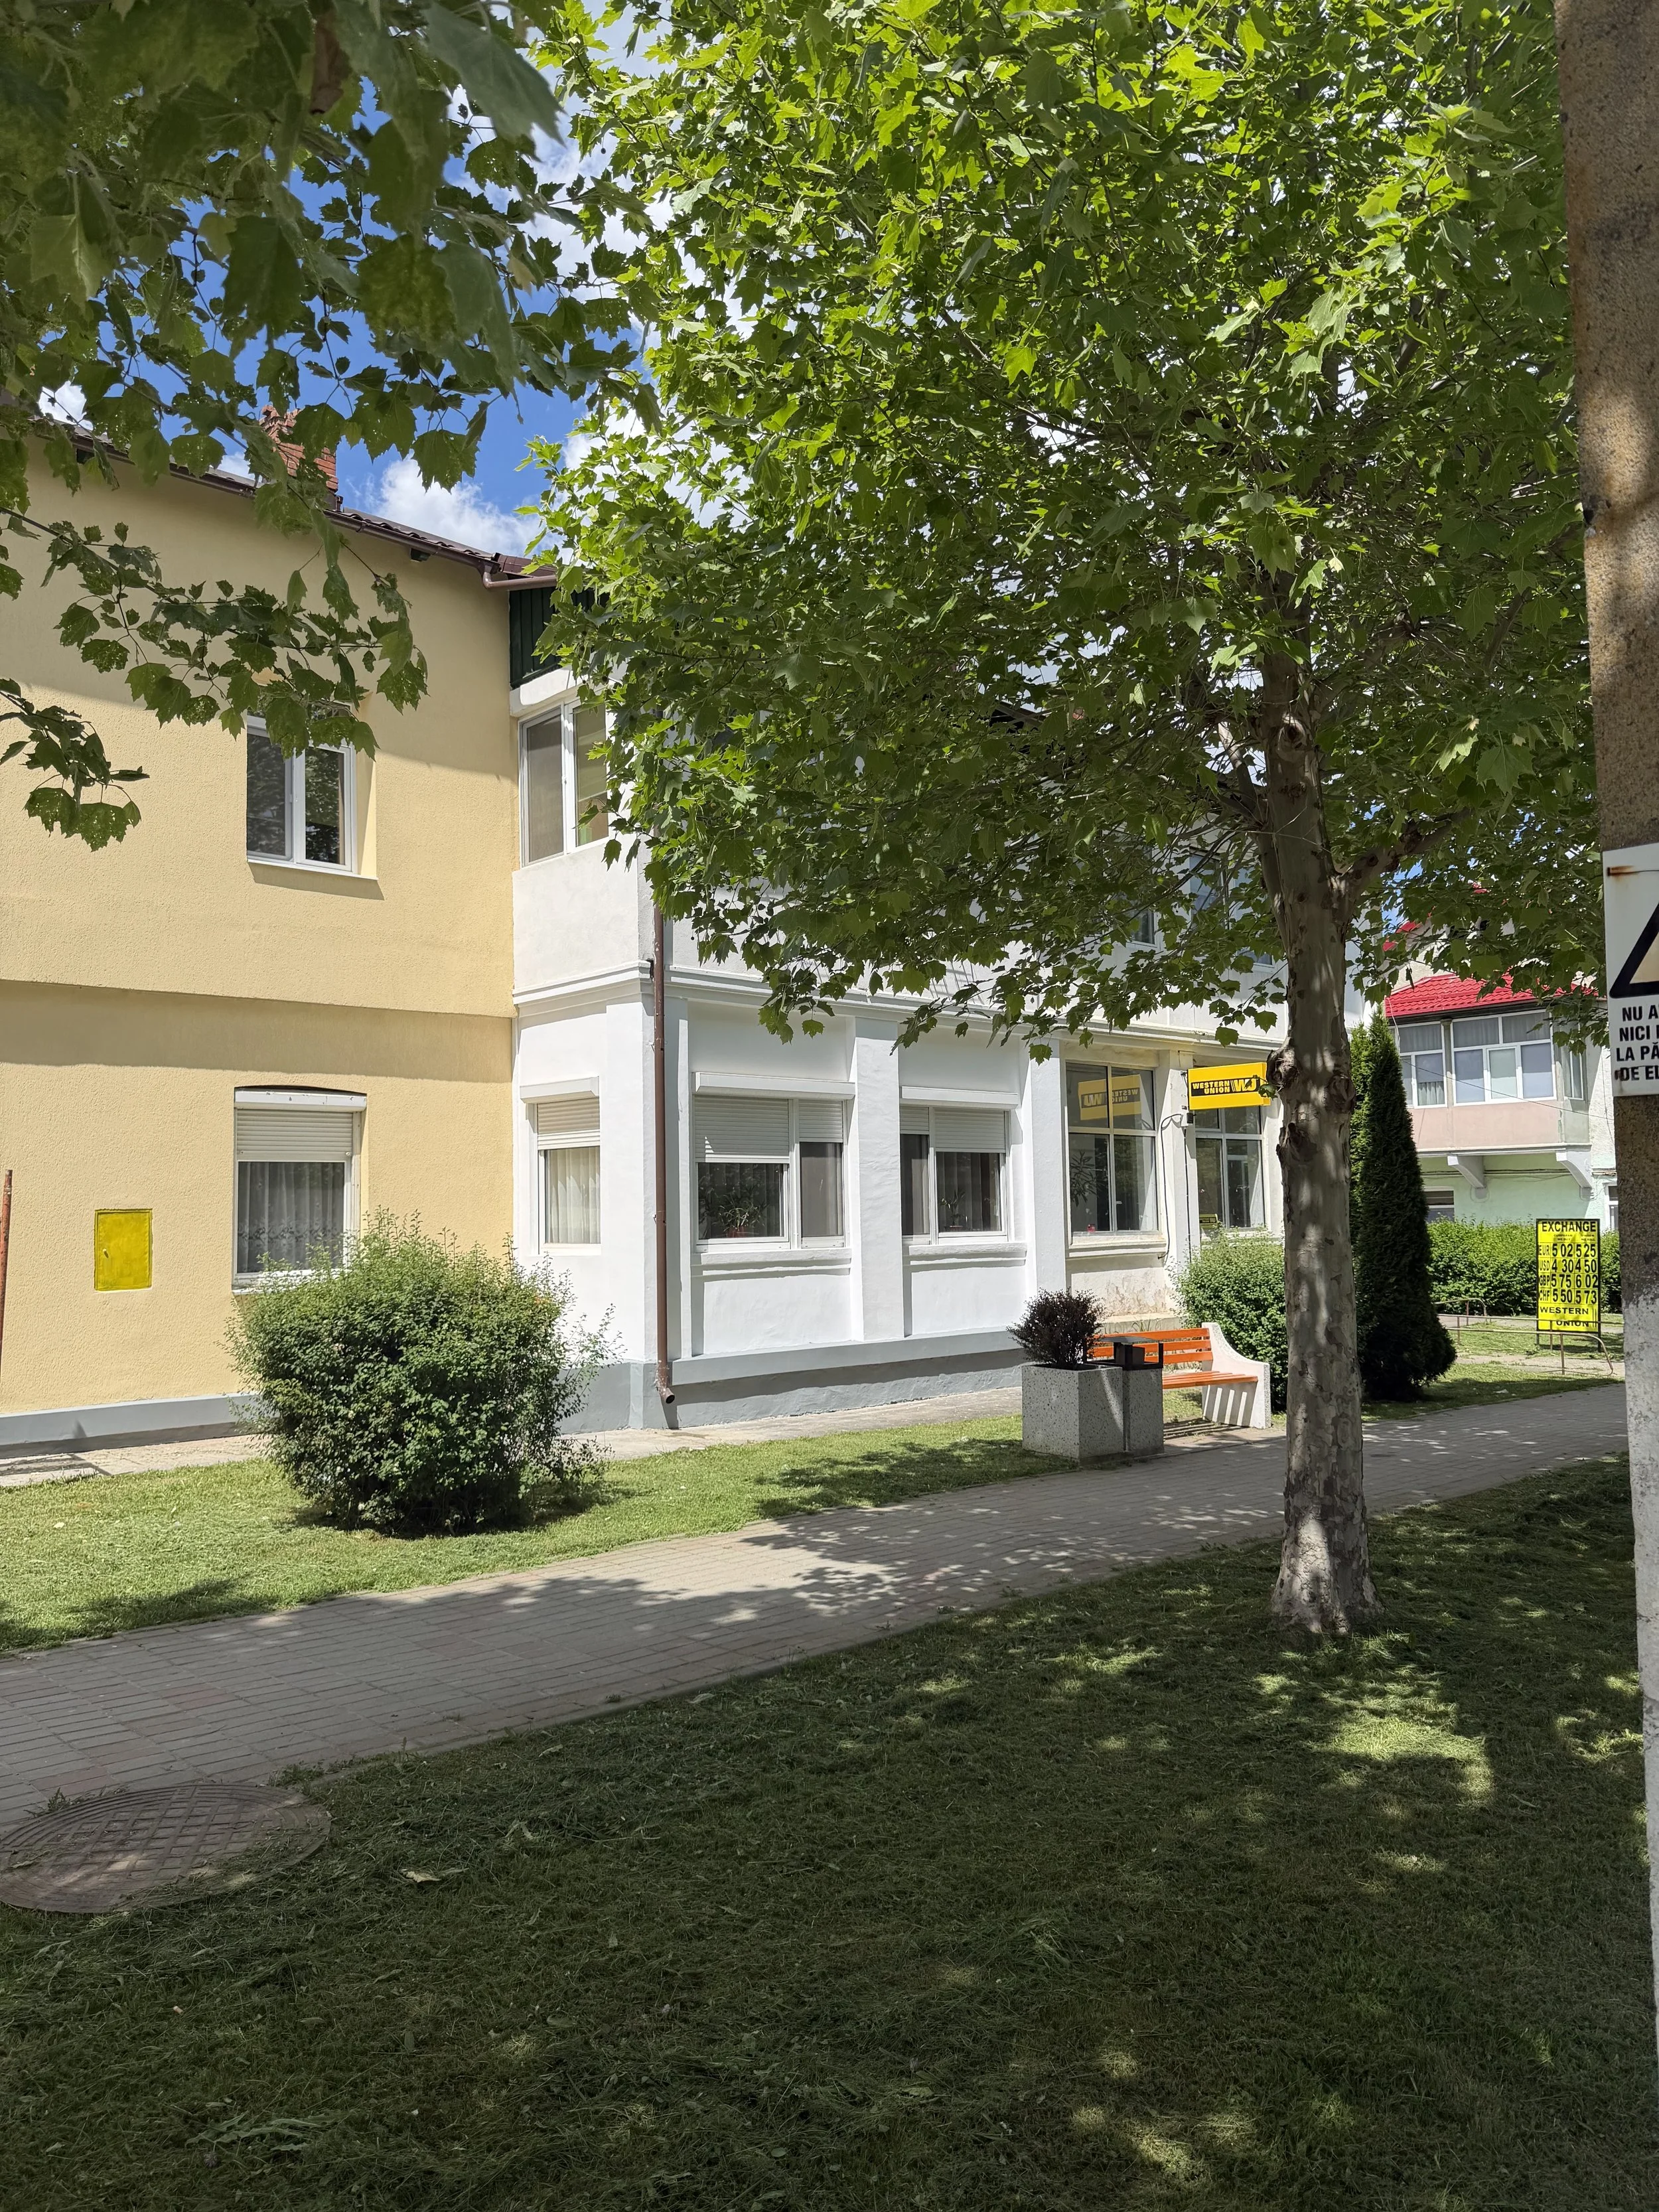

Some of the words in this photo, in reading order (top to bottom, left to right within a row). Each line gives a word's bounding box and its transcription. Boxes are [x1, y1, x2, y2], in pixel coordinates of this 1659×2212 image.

[1623, 1006, 1642, 1021] NU
[1648, 1004, 1659, 1019] A
[1619, 1025, 1650, 1041] NICI
[1617, 1047, 1635, 1062] LA
[1620, 1067, 1640, 1081] DE
[1192, 1080, 1230, 1090] WESTERN
[1542, 1221, 1597, 1232] EXCHANGE
[1539, 1244, 1550, 1256] EUR
[1539, 1260, 1550, 1271] USD
[1539, 1275, 1550, 1286] GBP
[1539, 1290, 1550, 1301] CHF
[1540, 1306, 1589, 1315] WESTERN
